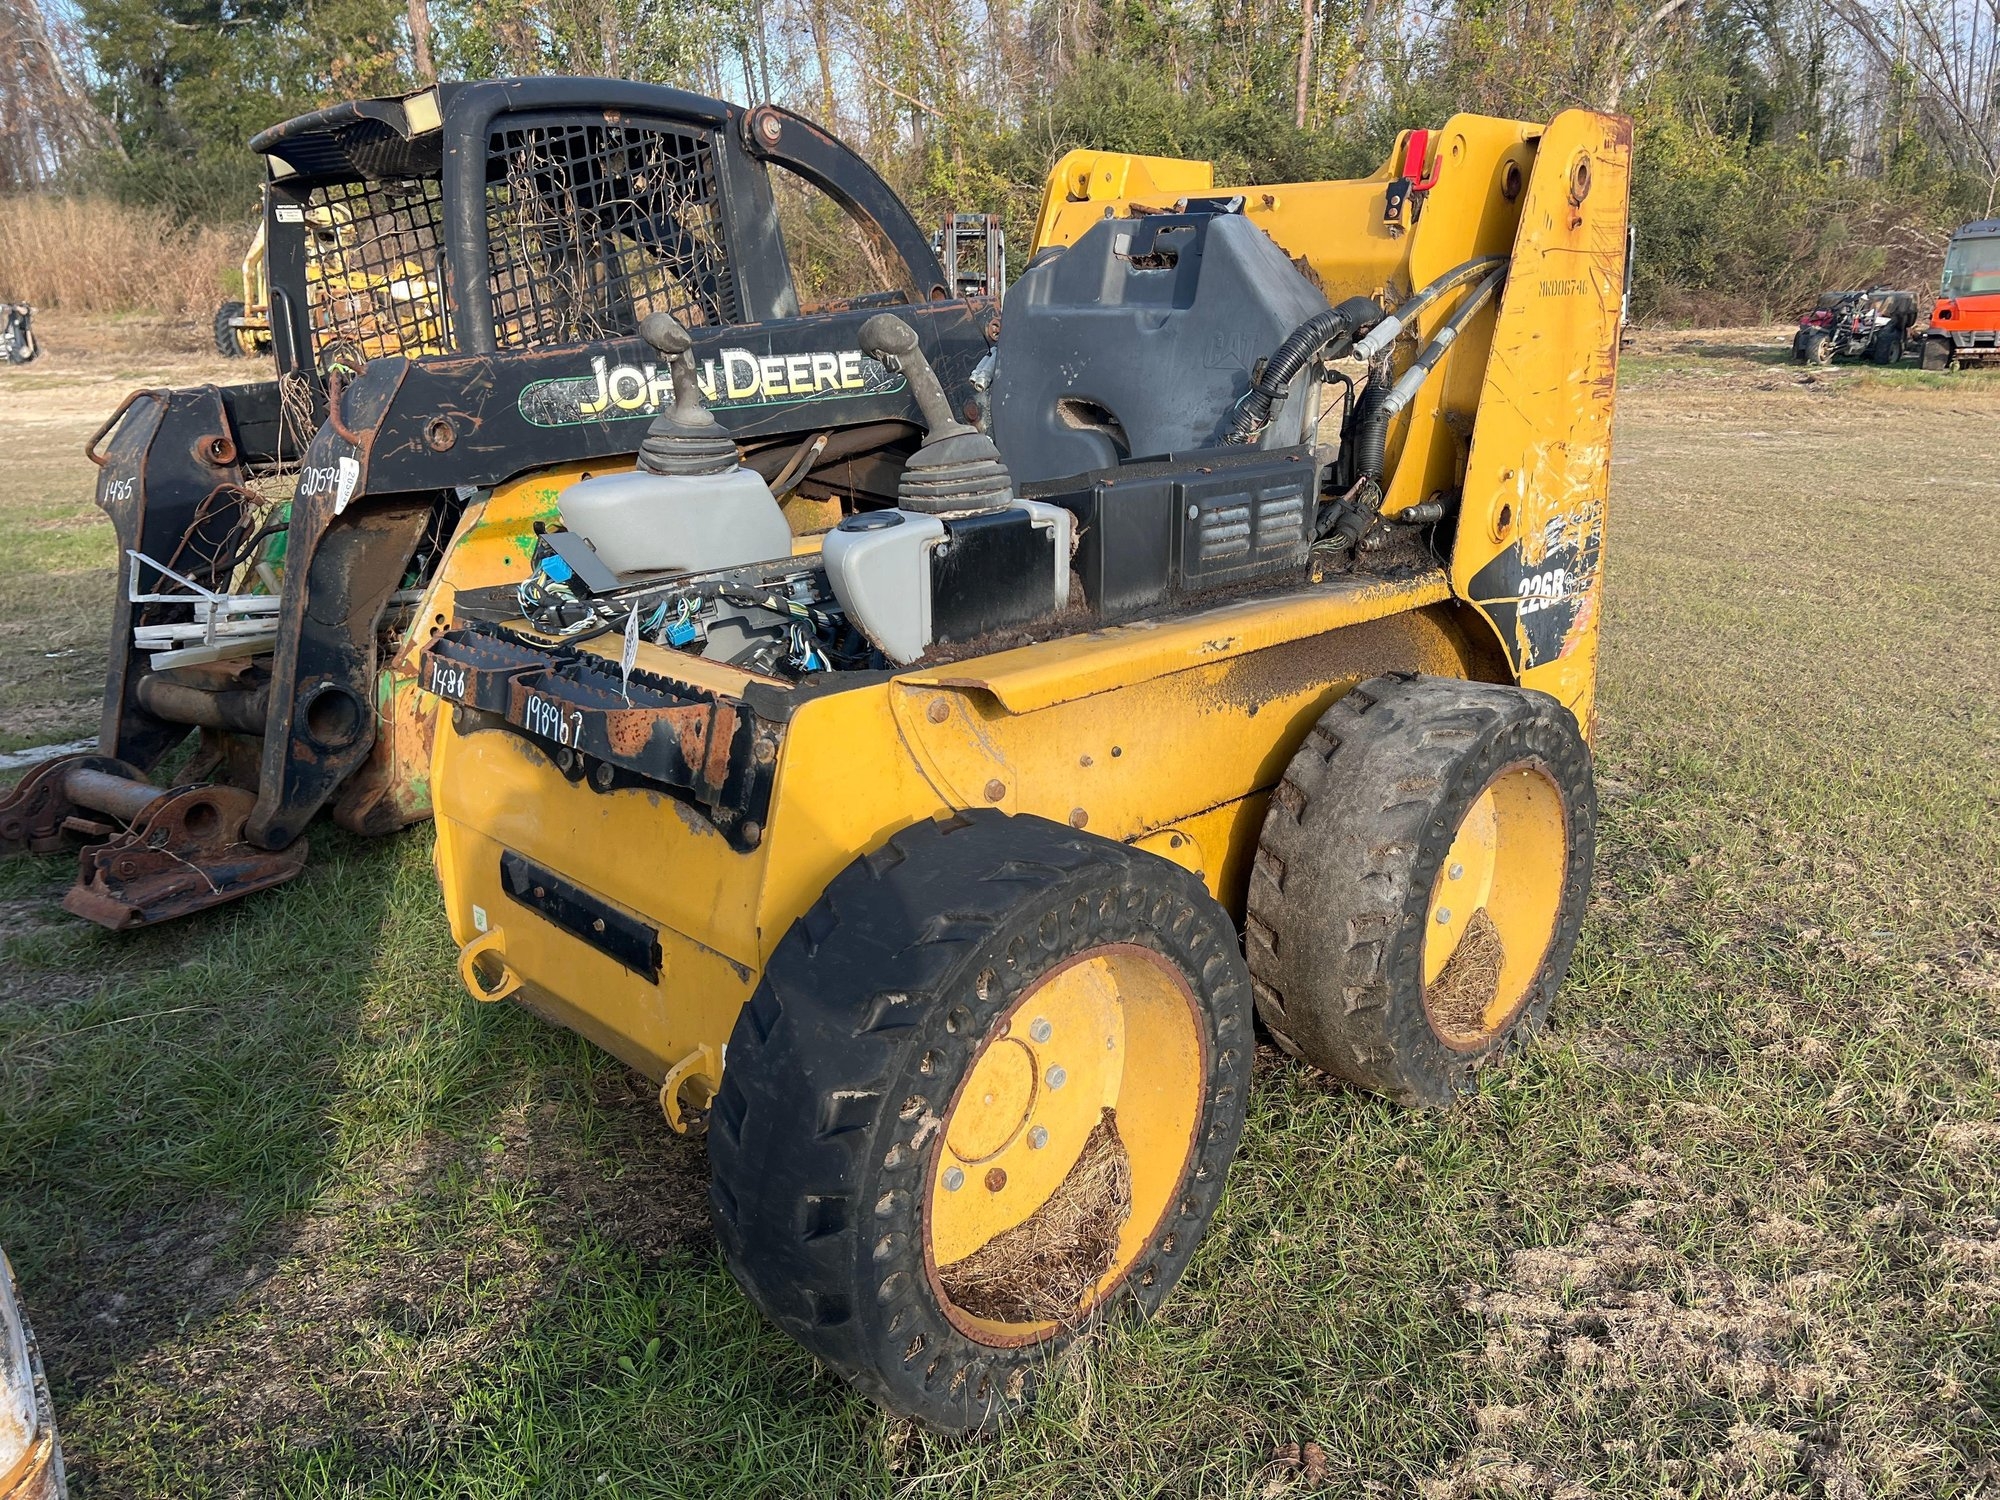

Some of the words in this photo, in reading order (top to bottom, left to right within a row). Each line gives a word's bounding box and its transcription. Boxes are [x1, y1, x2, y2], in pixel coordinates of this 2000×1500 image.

[719, 347, 865, 401] DEERE
[103, 476, 137, 503] 1485
[431, 661, 465, 698] 1486
[525, 695, 583, 749] 198967
